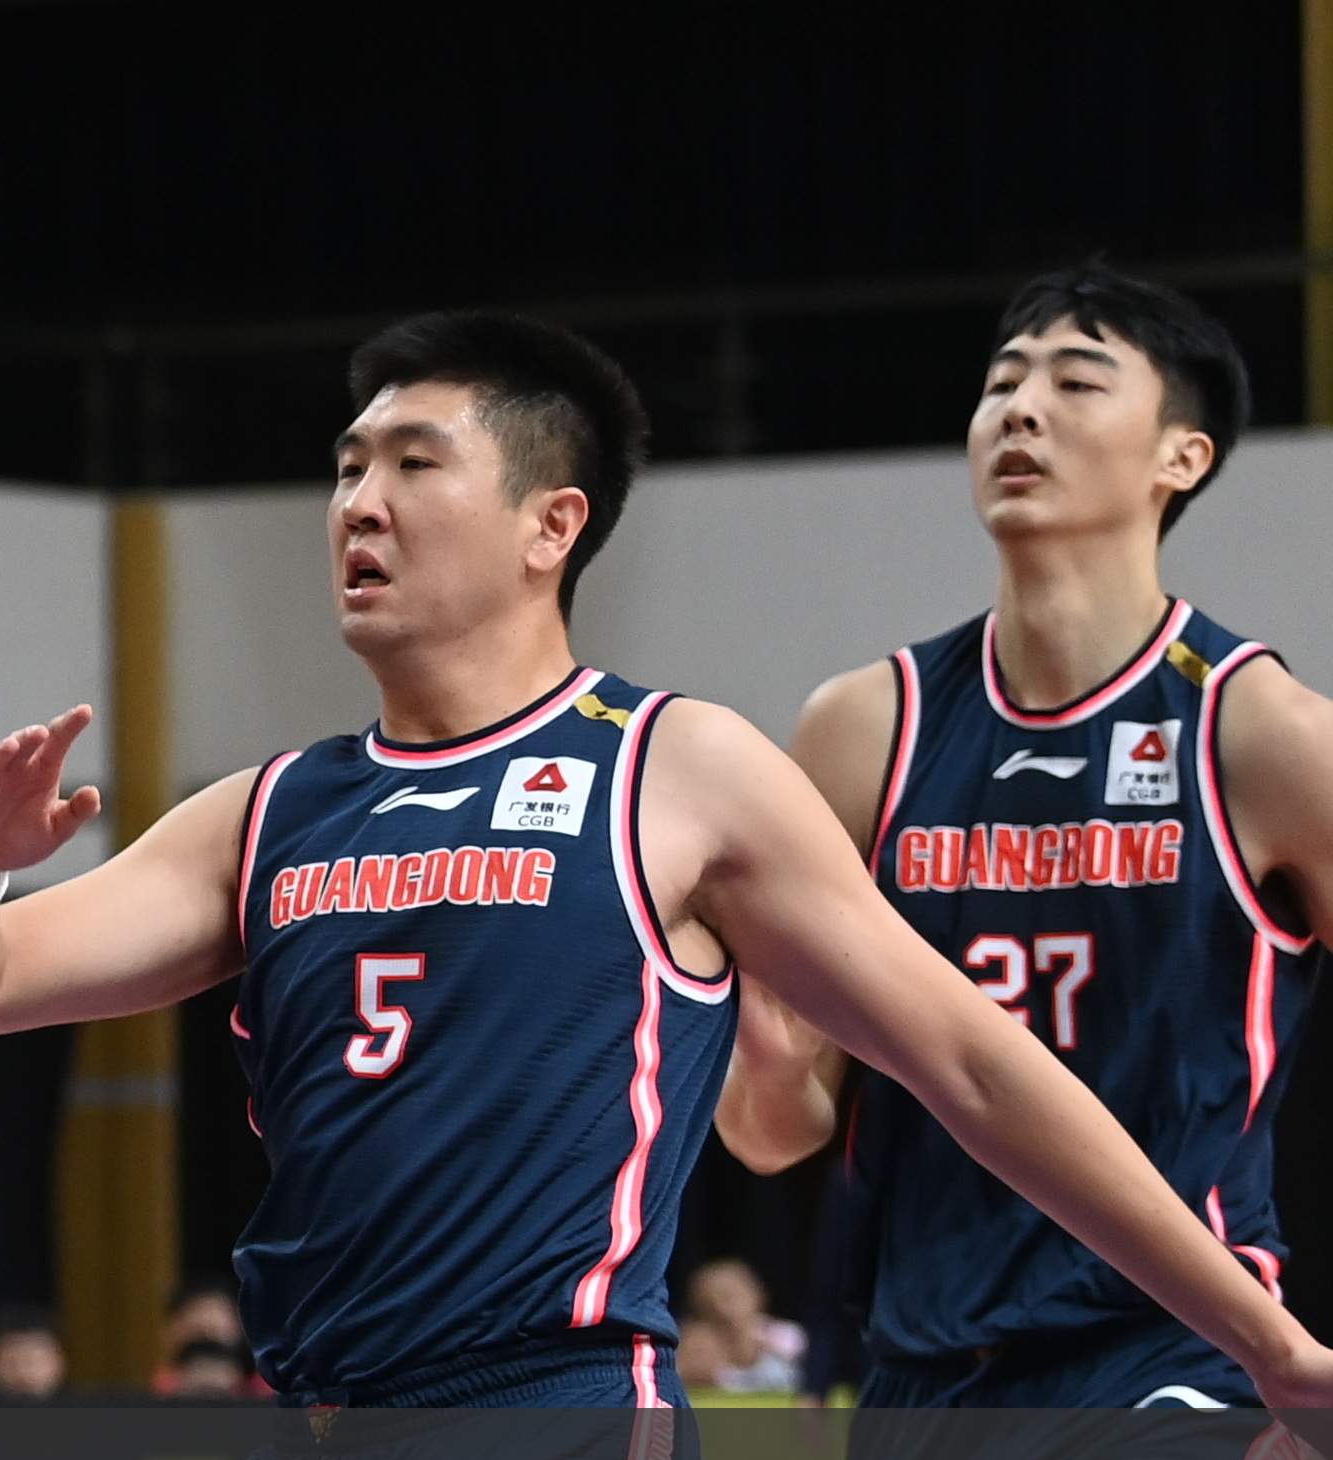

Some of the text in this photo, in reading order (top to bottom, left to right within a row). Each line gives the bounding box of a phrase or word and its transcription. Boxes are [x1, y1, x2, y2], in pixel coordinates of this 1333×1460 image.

[518, 815, 555, 827] CGB
[896, 819, 1184, 893] GUANGDONG
[270, 846, 557, 930] GUANGDONG
[344, 953, 426, 1079] 5
[963, 932, 1093, 1050] 27
